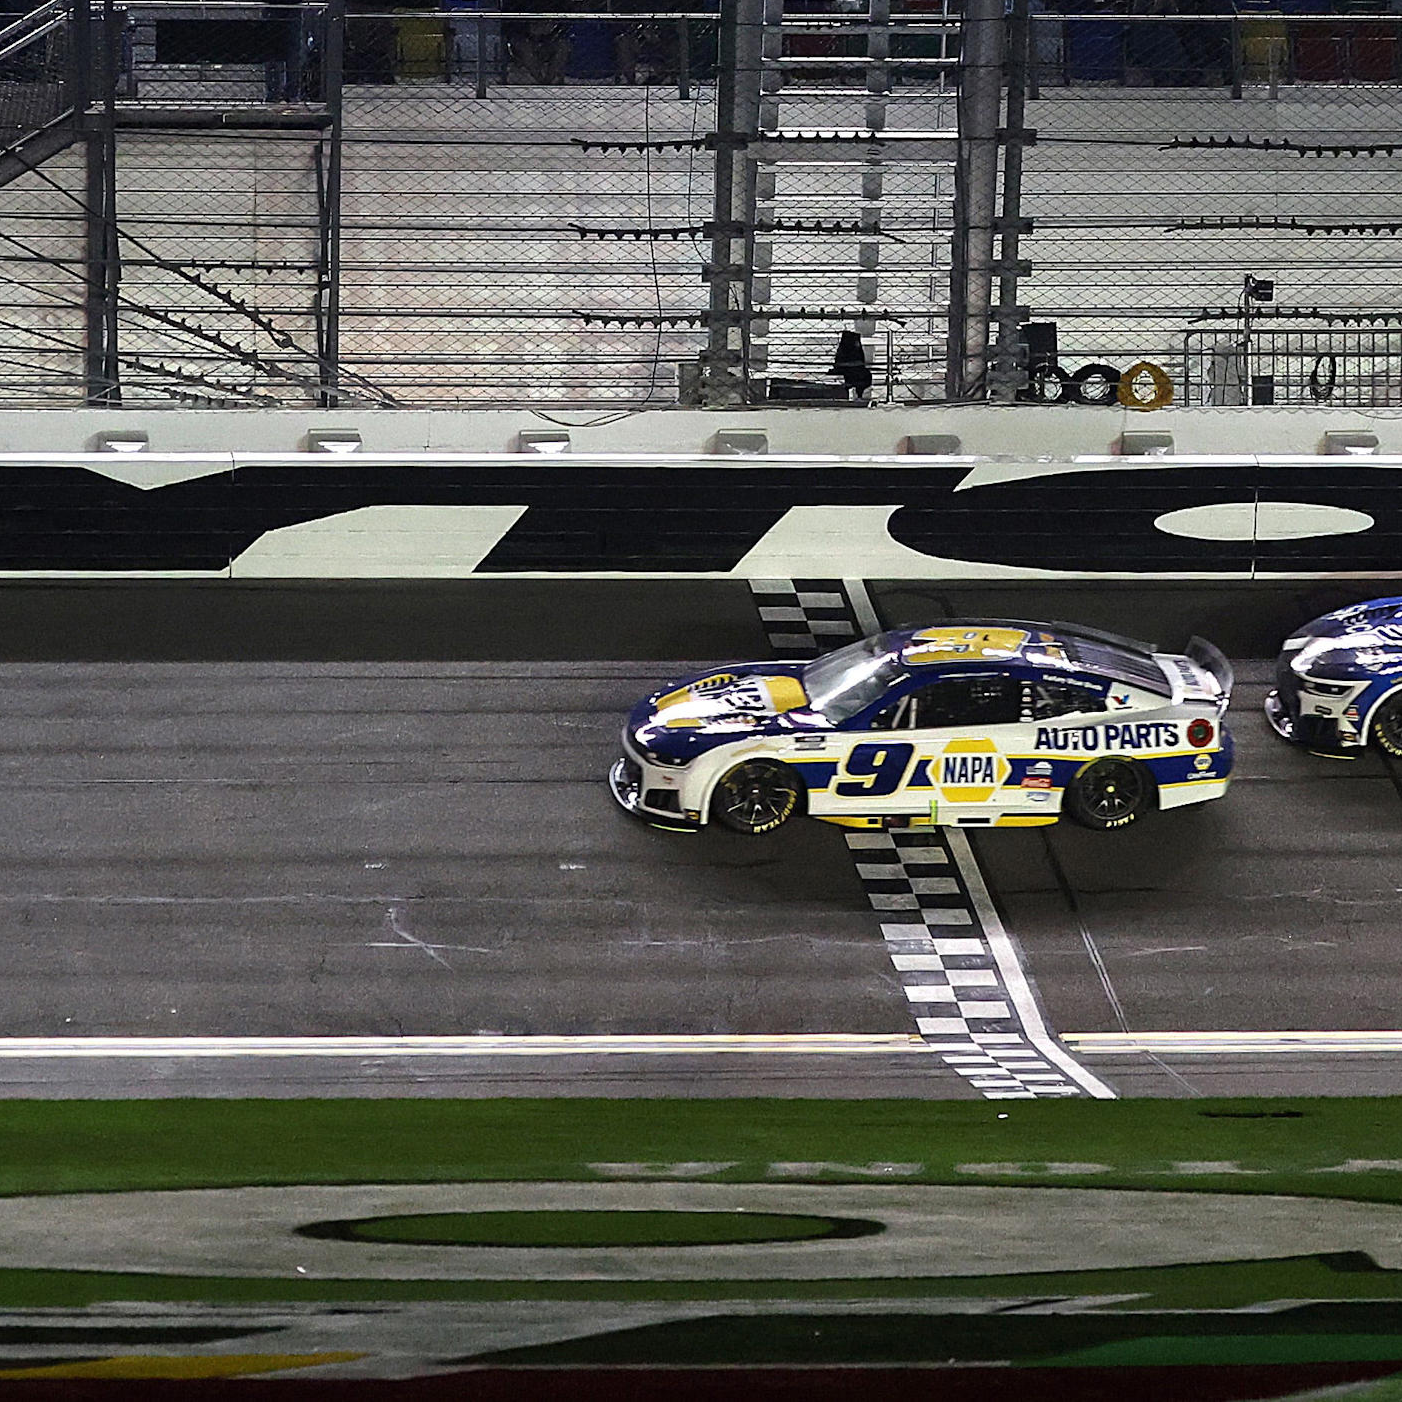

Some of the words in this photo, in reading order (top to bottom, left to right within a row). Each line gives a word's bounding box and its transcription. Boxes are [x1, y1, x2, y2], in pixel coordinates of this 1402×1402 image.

[1034, 725, 1098, 750] AUTO
[1104, 723, 1179, 749] PARTS
[834, 742, 916, 797] 9
[943, 756, 994, 784] NAPA
